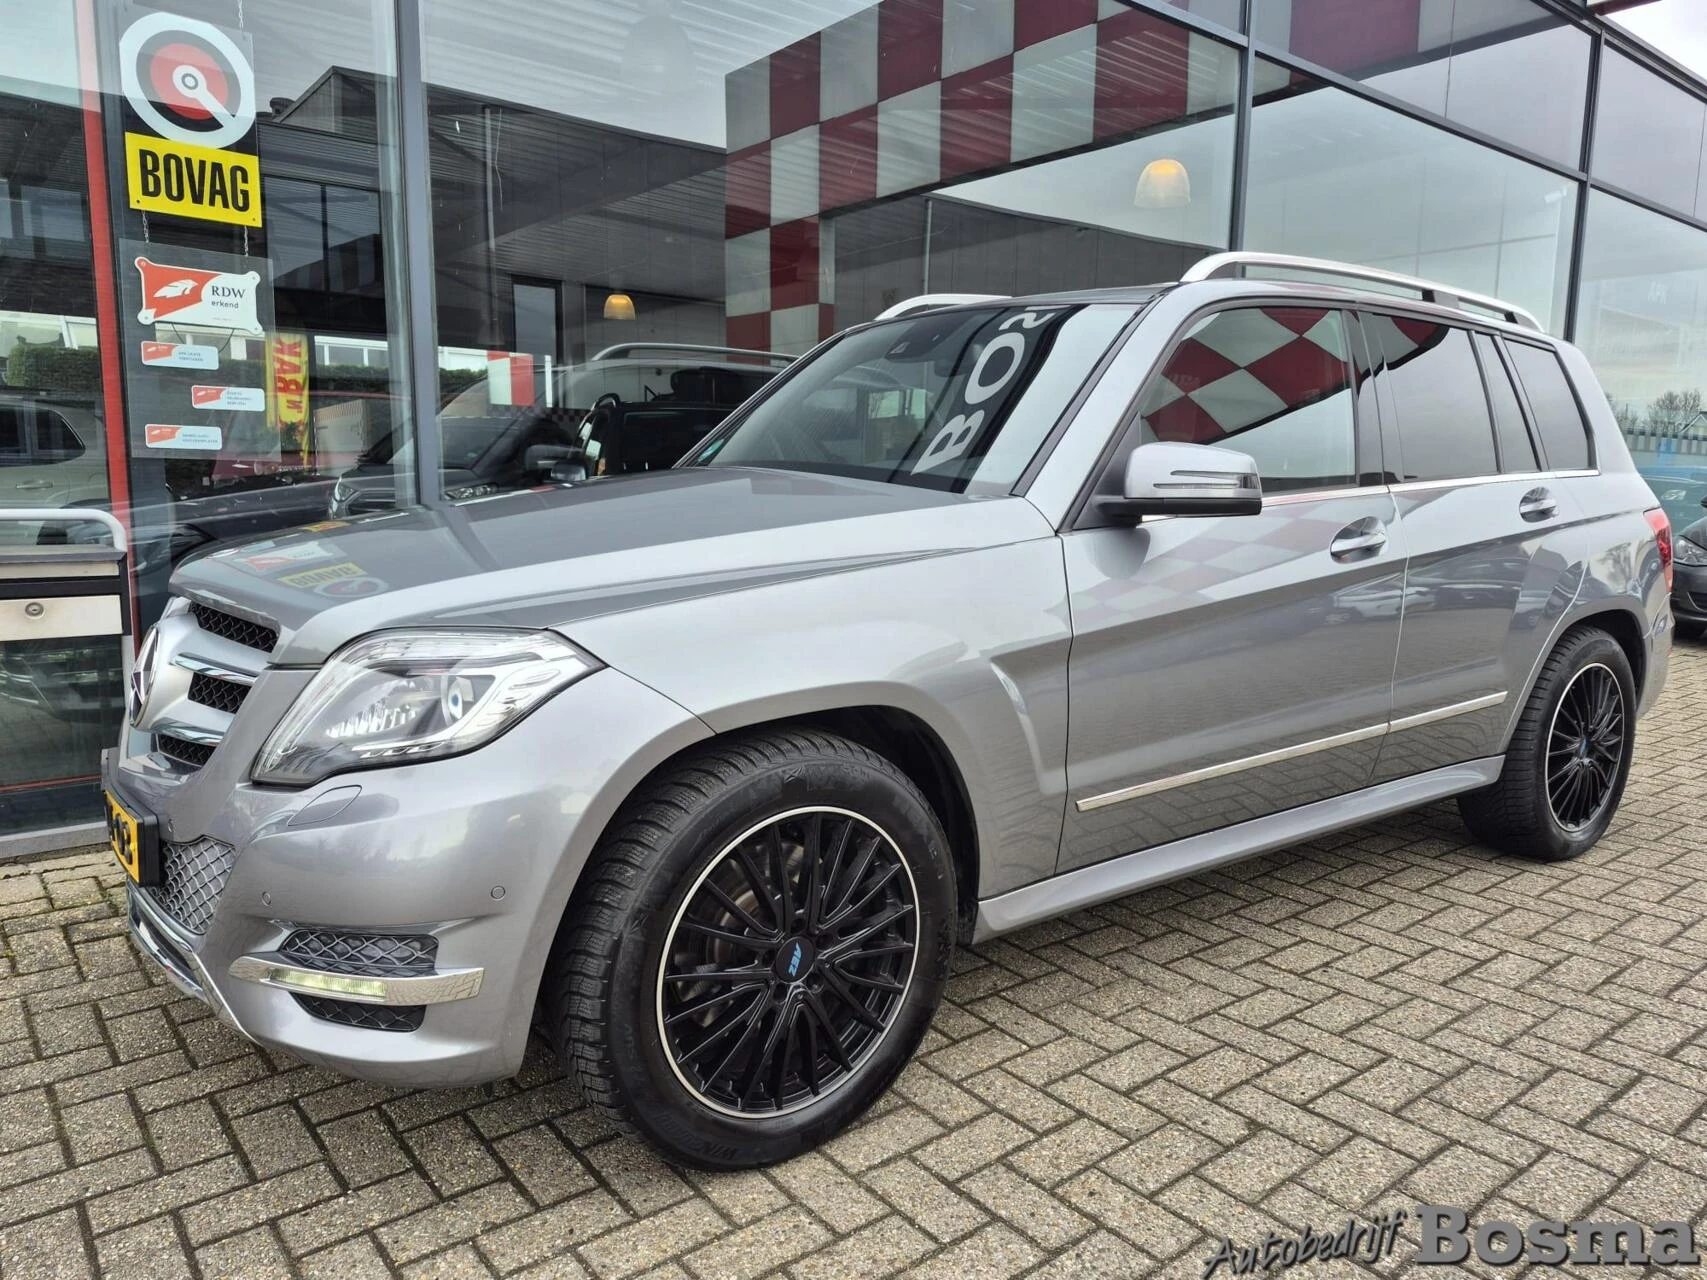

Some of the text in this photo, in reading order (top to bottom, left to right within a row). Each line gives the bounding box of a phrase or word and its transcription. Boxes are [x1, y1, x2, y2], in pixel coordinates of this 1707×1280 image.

[139, 148, 250, 213] BOVAG
[211, 285, 246, 299] RDW
[211, 299, 240, 309] erkend
